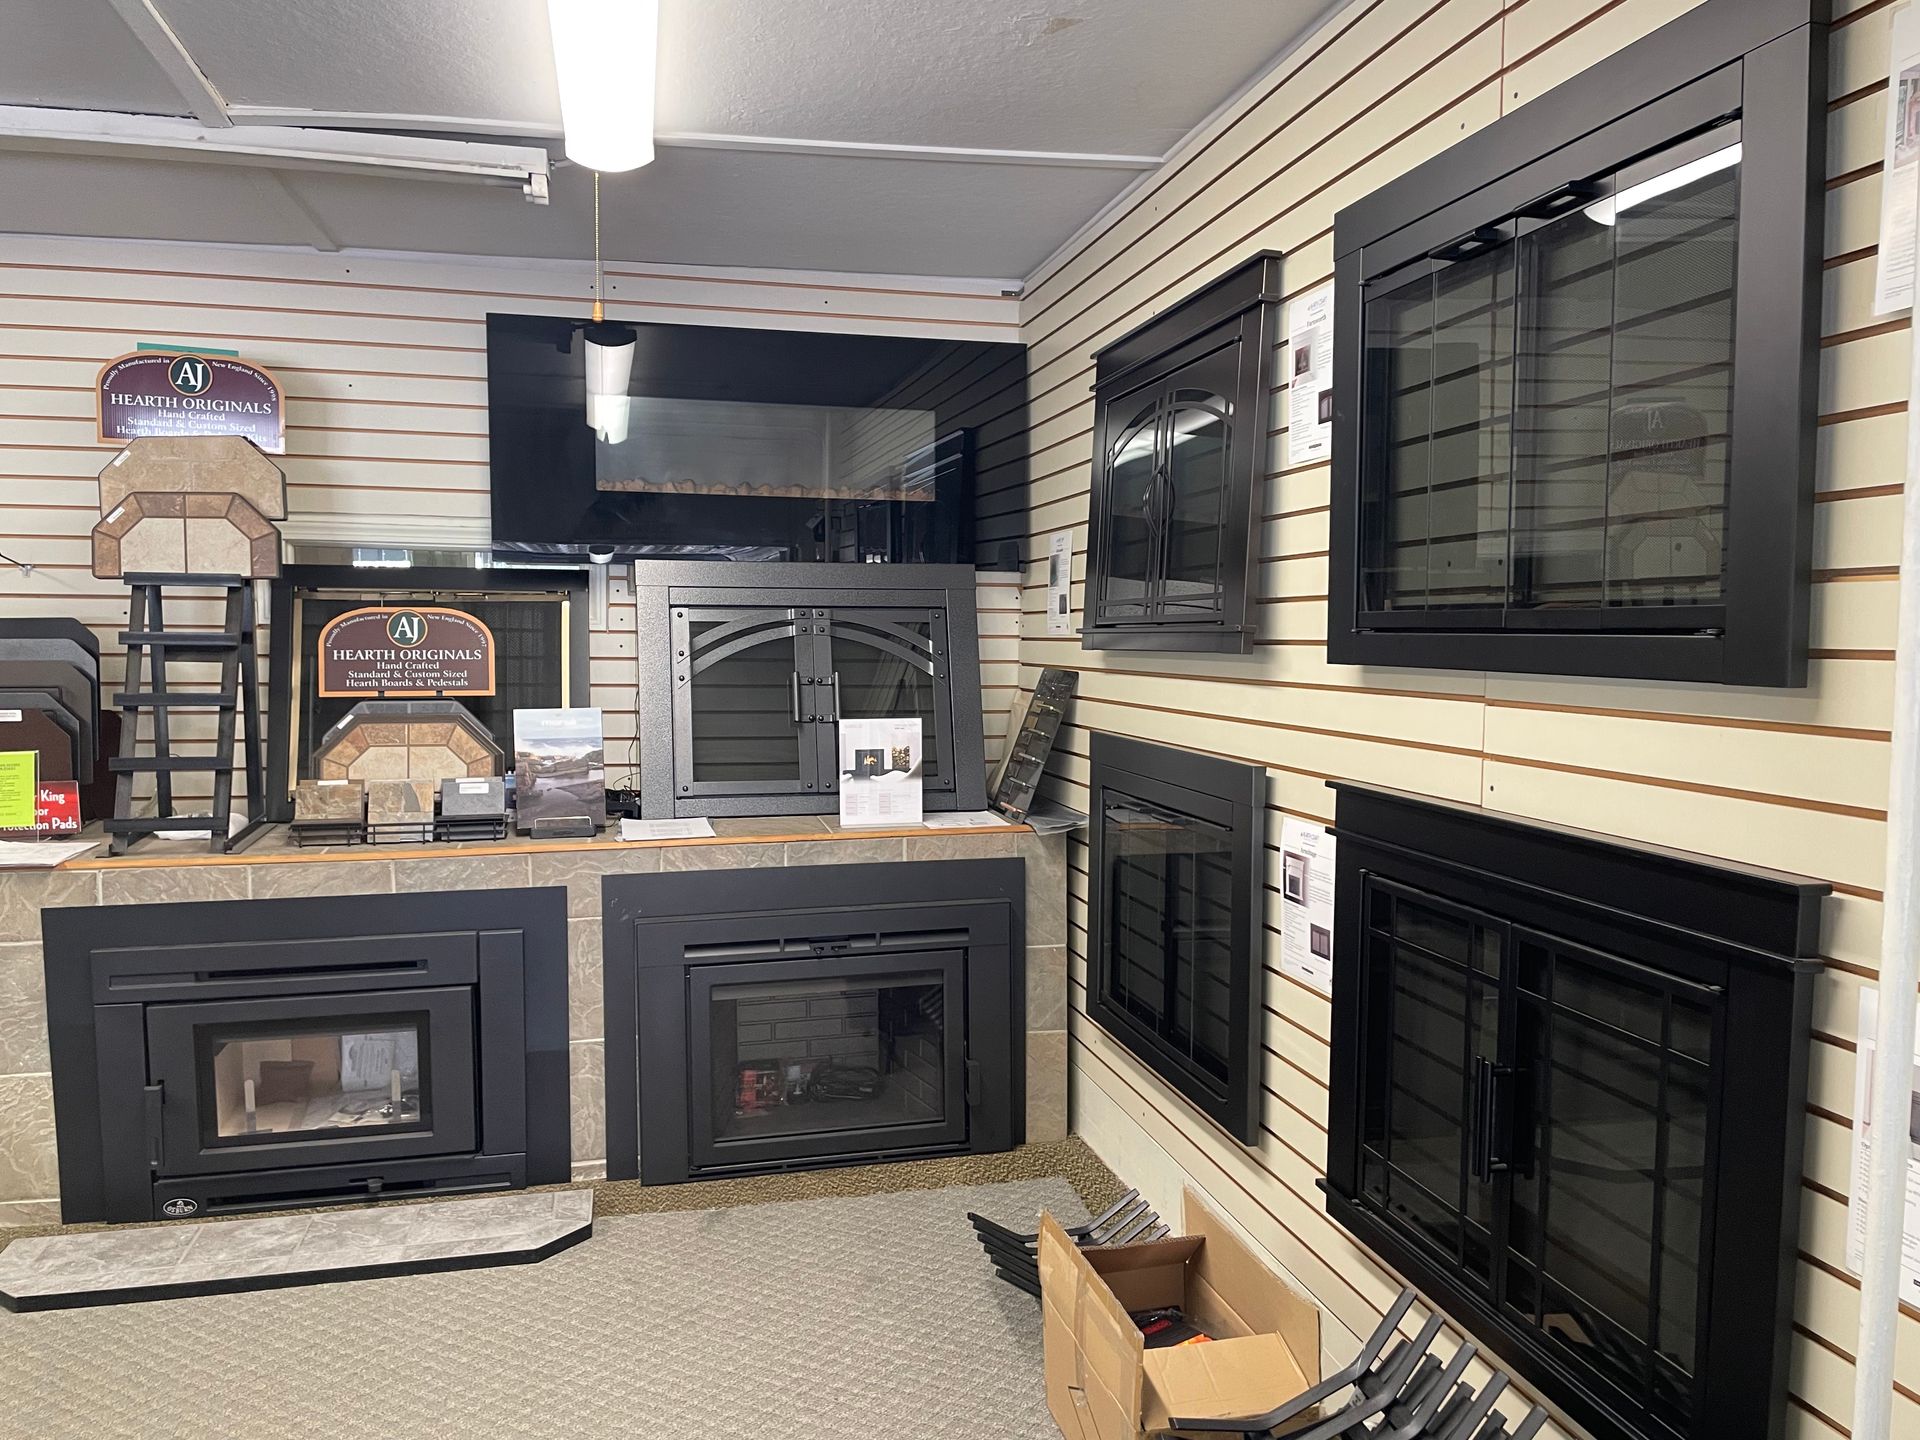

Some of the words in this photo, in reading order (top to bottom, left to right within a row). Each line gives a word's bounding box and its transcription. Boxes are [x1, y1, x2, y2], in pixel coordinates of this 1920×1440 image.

[103, 369, 119, 390] Proudly
[118, 357, 161, 370] Manufactured
[228, 363, 253, 376] England
[254, 373, 268, 386] Since
[175, 361, 205, 392] AJ
[111, 393, 177, 409] HEARTH
[182, 398, 272, 415] ORIGINALS
[158, 410, 185, 419] Hand
[188, 411, 226, 421] Crafted
[116, 426, 151, 436] Hearth
[127, 416, 173, 427] Standard
[176, 418, 186, 428] &
[188, 420, 227, 431] Custom
[230, 422, 256, 432] Sized
[326, 628, 340, 647] Proudly
[340, 615, 381, 628] Manufactured
[441, 615, 465, 625] England
[465, 621, 479, 634] Since
[393, 616, 420, 644] AJ
[333, 649, 395, 661] HEARTH
[400, 649, 482, 661] ORIGINALS
[377, 662, 403, 670] Hand
[405, 661, 440, 670] Crafted
[348, 670, 390, 679] Standard
[393, 671, 402, 679] &
[405, 670, 441, 678] Custom
[443, 670, 468, 678] Sized
[346, 679, 379, 687] Hearth
[381, 679, 413, 687] Boards
[415, 679, 425, 687] &
[427, 678, 469, 687] Pedestals
[40, 790, 65, 805] King
[52, 816, 78, 830] Pads
